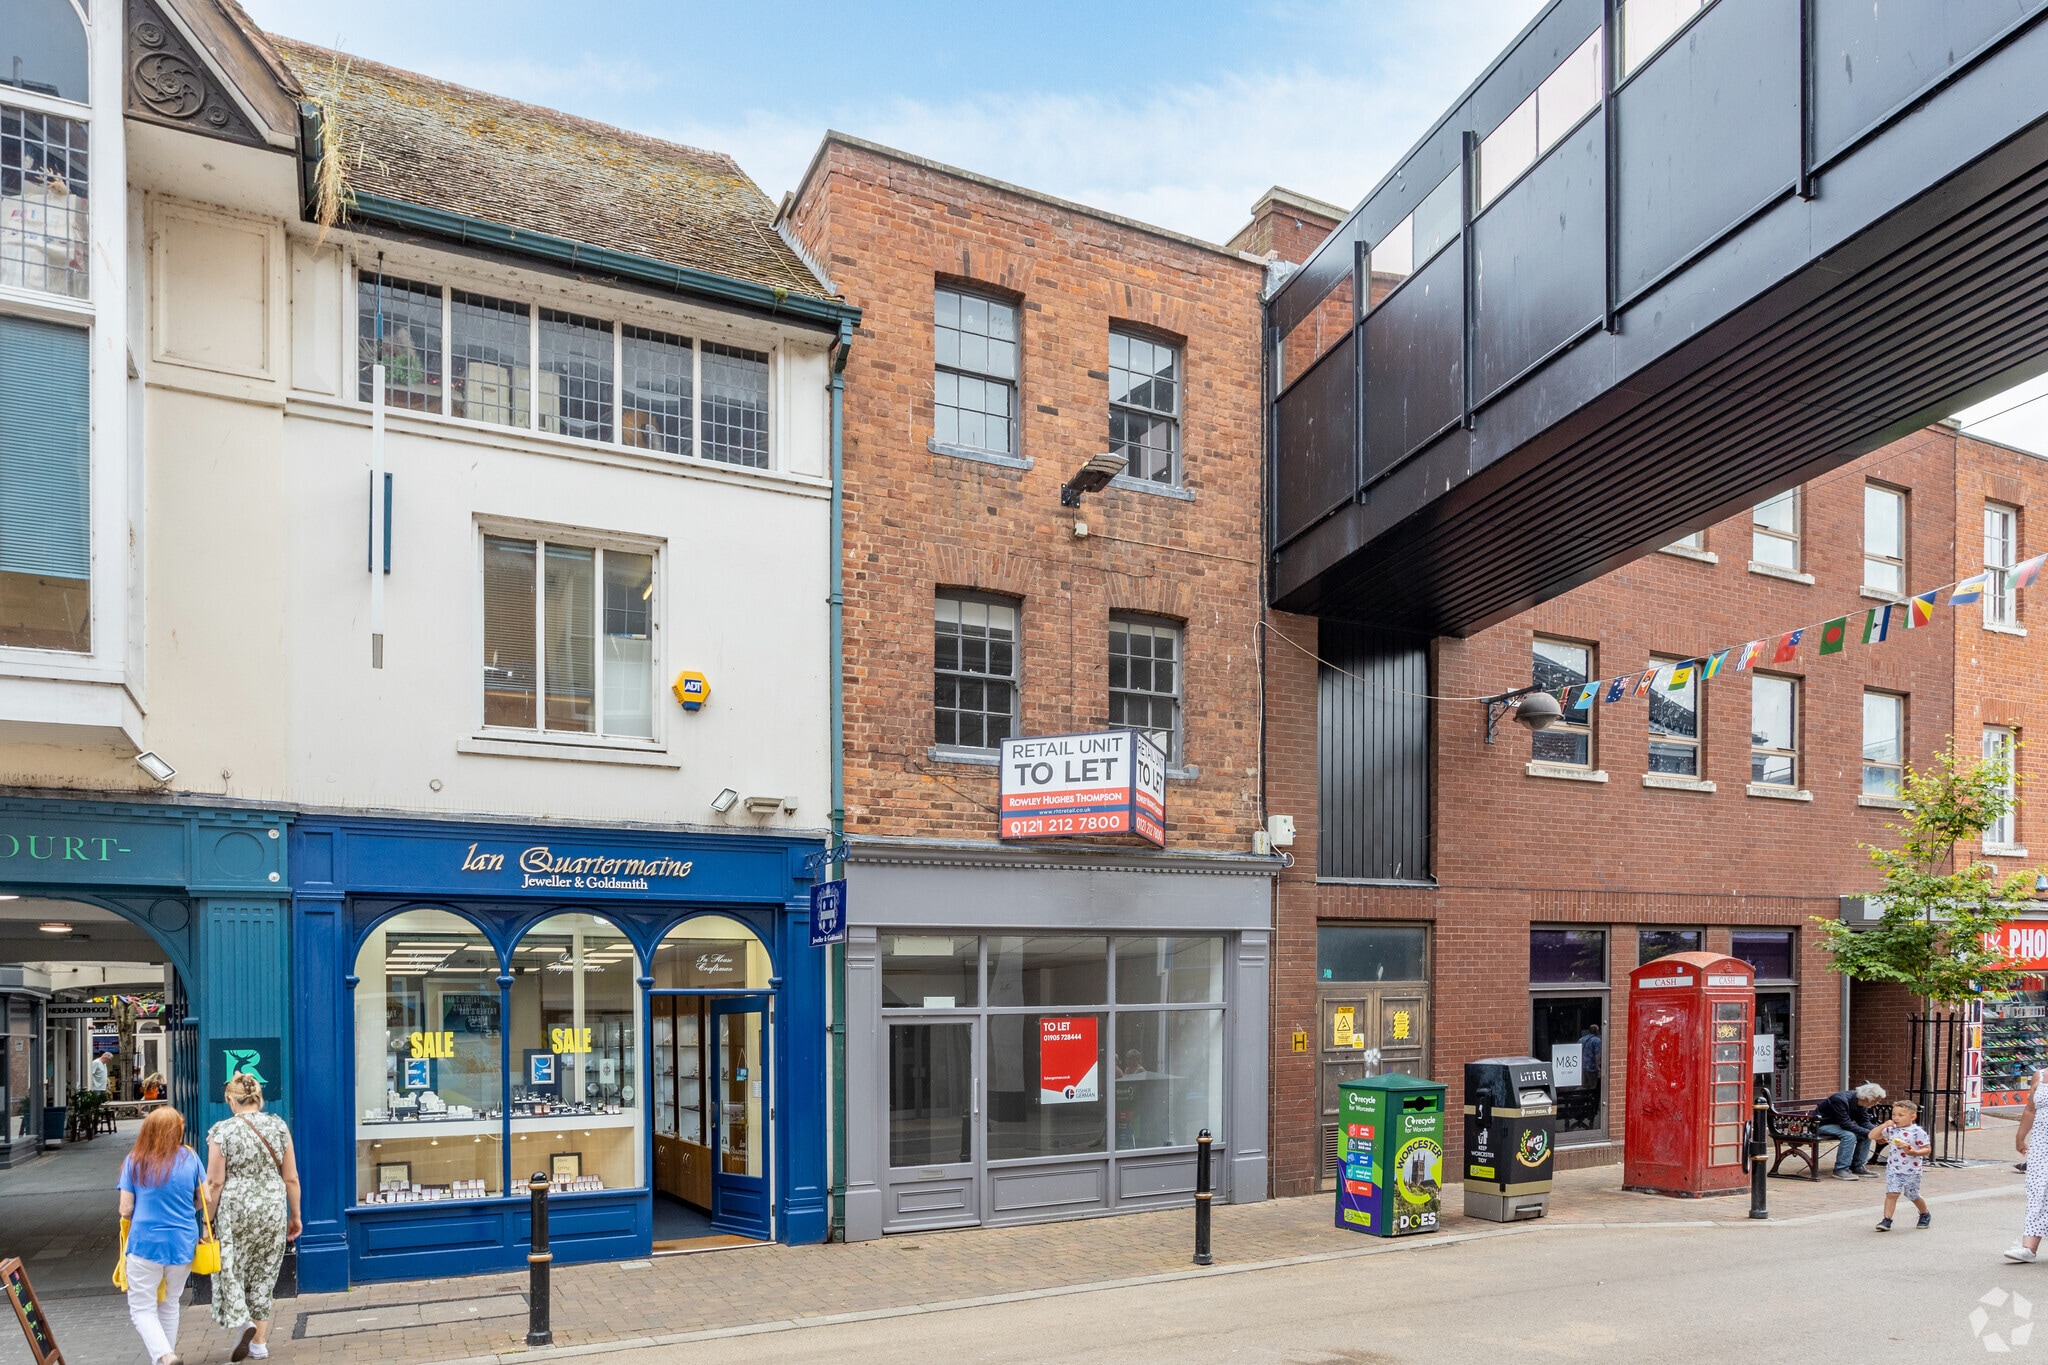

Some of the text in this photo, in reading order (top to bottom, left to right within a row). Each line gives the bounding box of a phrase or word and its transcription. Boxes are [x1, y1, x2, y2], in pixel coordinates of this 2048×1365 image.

[685, 681, 702, 692] ADT
[1012, 737, 1123, 759] RETAIL UNIT
[1014, 757, 1118, 786] TO LET
[1138, 759, 1163, 797] TO LET
[1009, 791, 1122, 808] ROWLEY HUGHES THOMPSON
[1011, 815, 1120, 834] 0121 212 7800
[519, 846, 693, 878] Quartermaine
[521, 874, 649, 890] Jeweller & Goldsmith
[2009, 928, 2048, 959] PHO
[711, 953, 733, 963] House
[695, 962, 733, 975] Craftsman
[1655, 978, 1677, 986] CASH
[1719, 976, 1735, 985] CASH
[1043, 1022, 1070, 1031] TO LET
[551, 1027, 592, 1054] SALE
[1061, 1033, 1082, 1041] 728444
[1293, 1034, 1305, 1050] H
[411, 1031, 454, 1058] SALE
[1754, 1045, 1771, 1057] M&S
[1556, 1056, 1578, 1068] M&S
[1520, 1071, 1548, 1082] LITTER
[1356, 1096, 1376, 1105] recycle
[1415, 1116, 1436, 1126] recycle
[1396, 1140, 1442, 1170] WORCESTER
